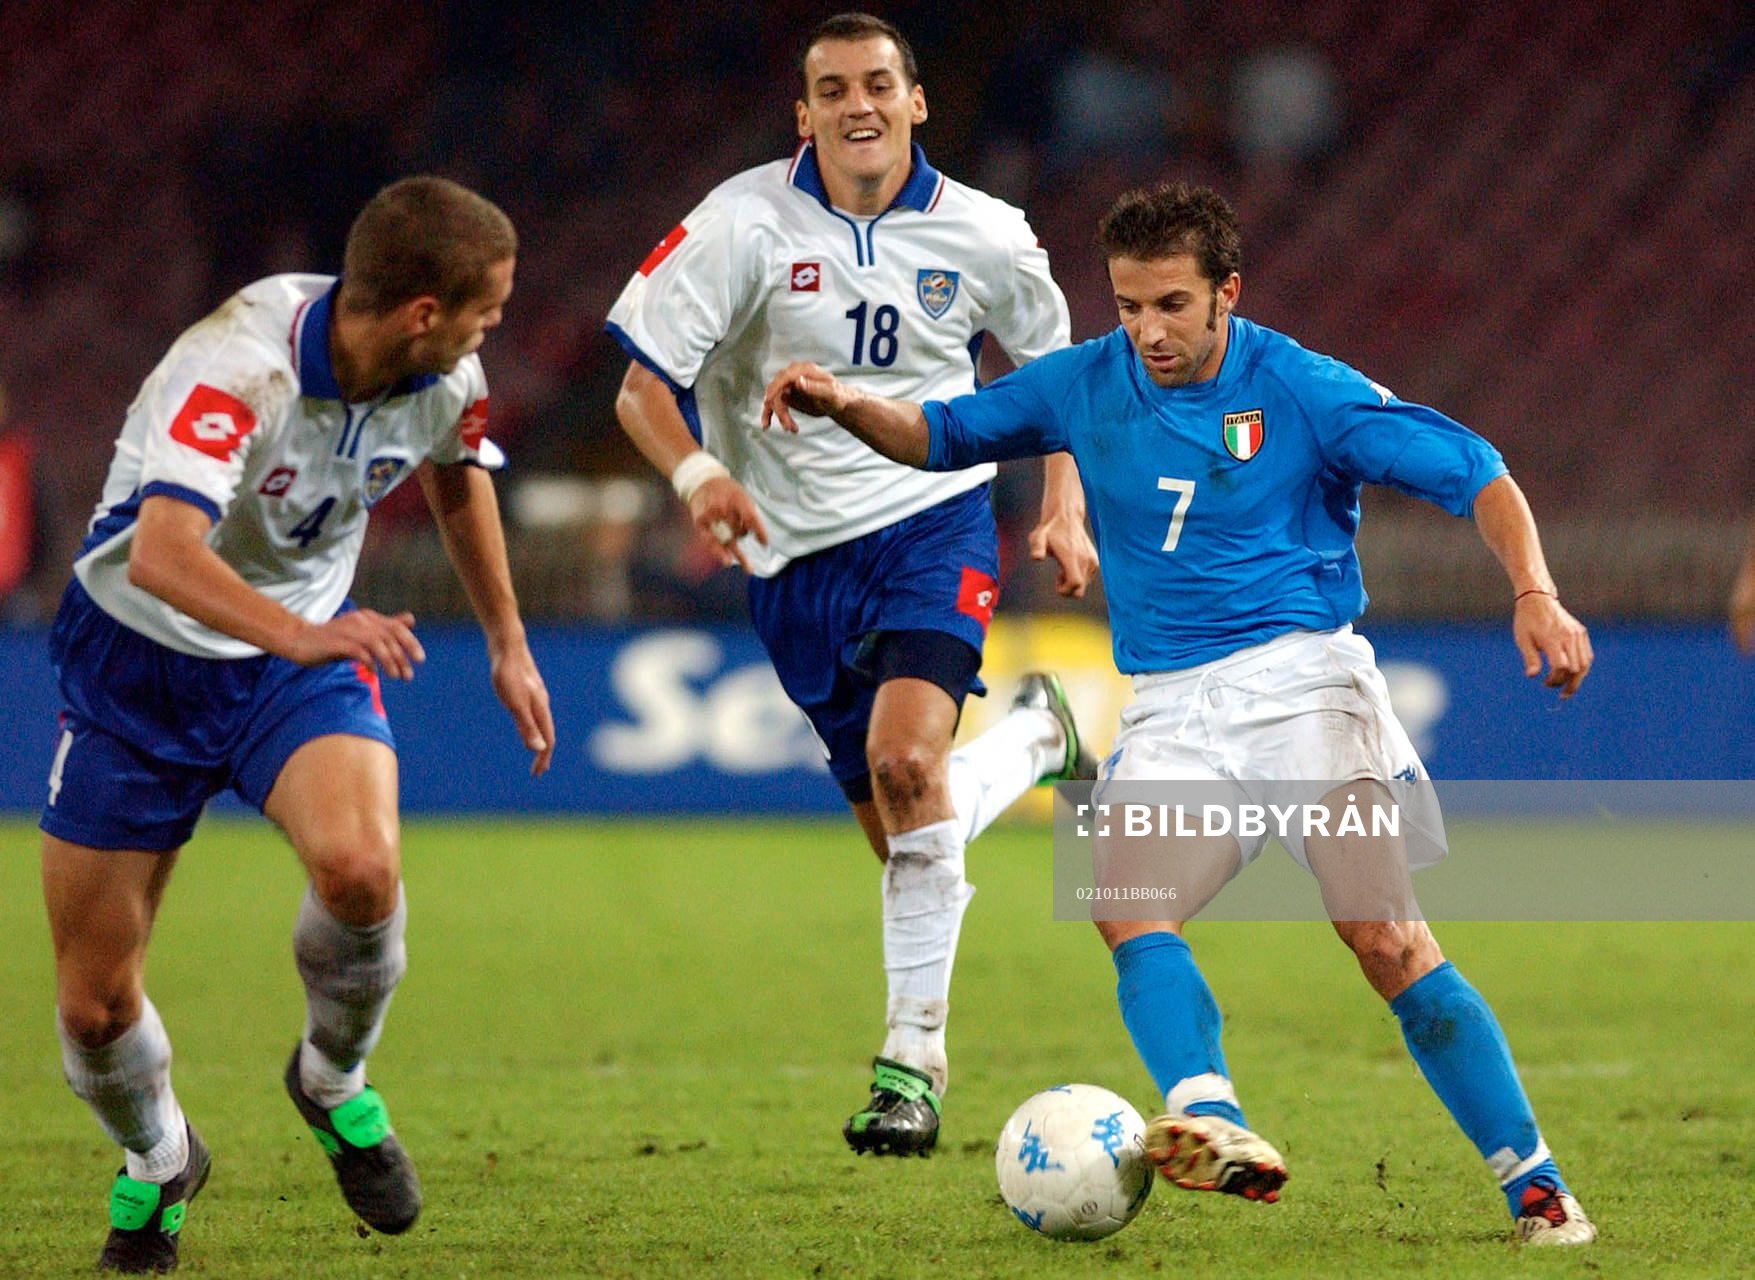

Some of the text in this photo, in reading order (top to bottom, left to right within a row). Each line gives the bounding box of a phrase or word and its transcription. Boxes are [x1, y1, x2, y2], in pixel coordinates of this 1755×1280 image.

[845, 301, 899, 367] 18
[1226, 412, 1261, 425] ITALIA
[288, 496, 337, 548] 4
[1157, 476, 1196, 552] 7
